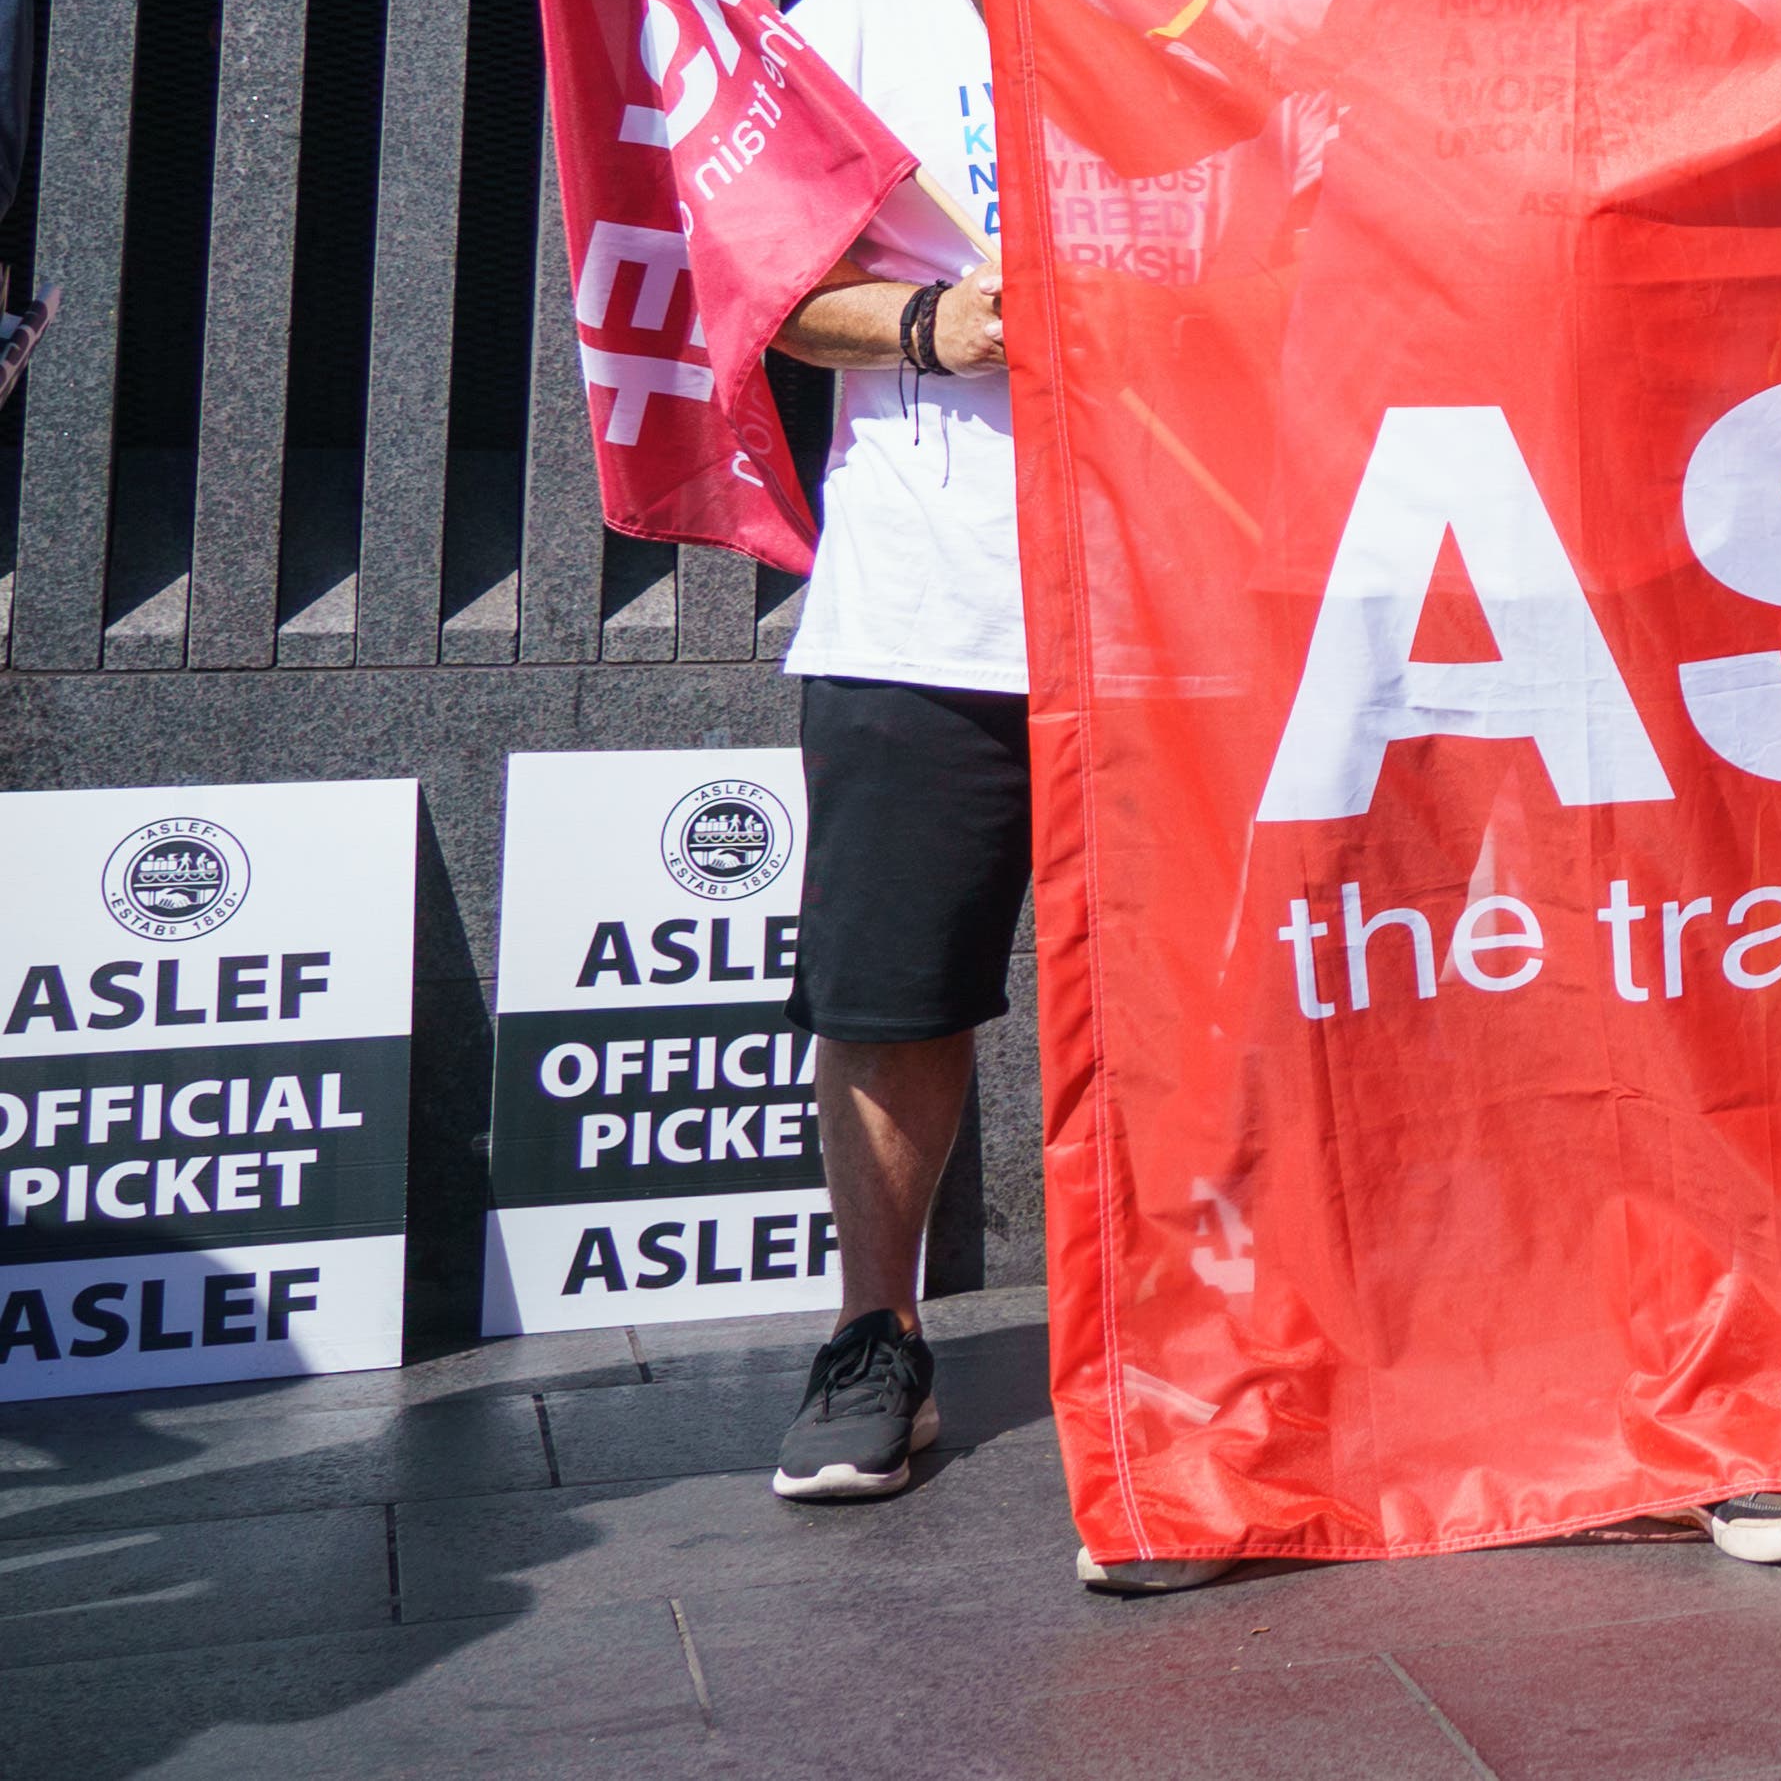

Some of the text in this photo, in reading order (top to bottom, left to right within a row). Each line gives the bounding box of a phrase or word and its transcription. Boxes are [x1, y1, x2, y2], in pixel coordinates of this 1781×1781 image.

[699, 783, 761, 802] ASLEF
[146, 821, 215, 841] ASLEF
[741, 858, 781, 892] 1880
[192, 897, 237, 932] 1880
[575, 914, 801, 989] ASLE
[1278, 881, 1545, 1020] the
[2, 951, 331, 1035] ASLEF
[8, 1149, 319, 1227] PICKET
[0, 1267, 321, 1366] ASLEF
